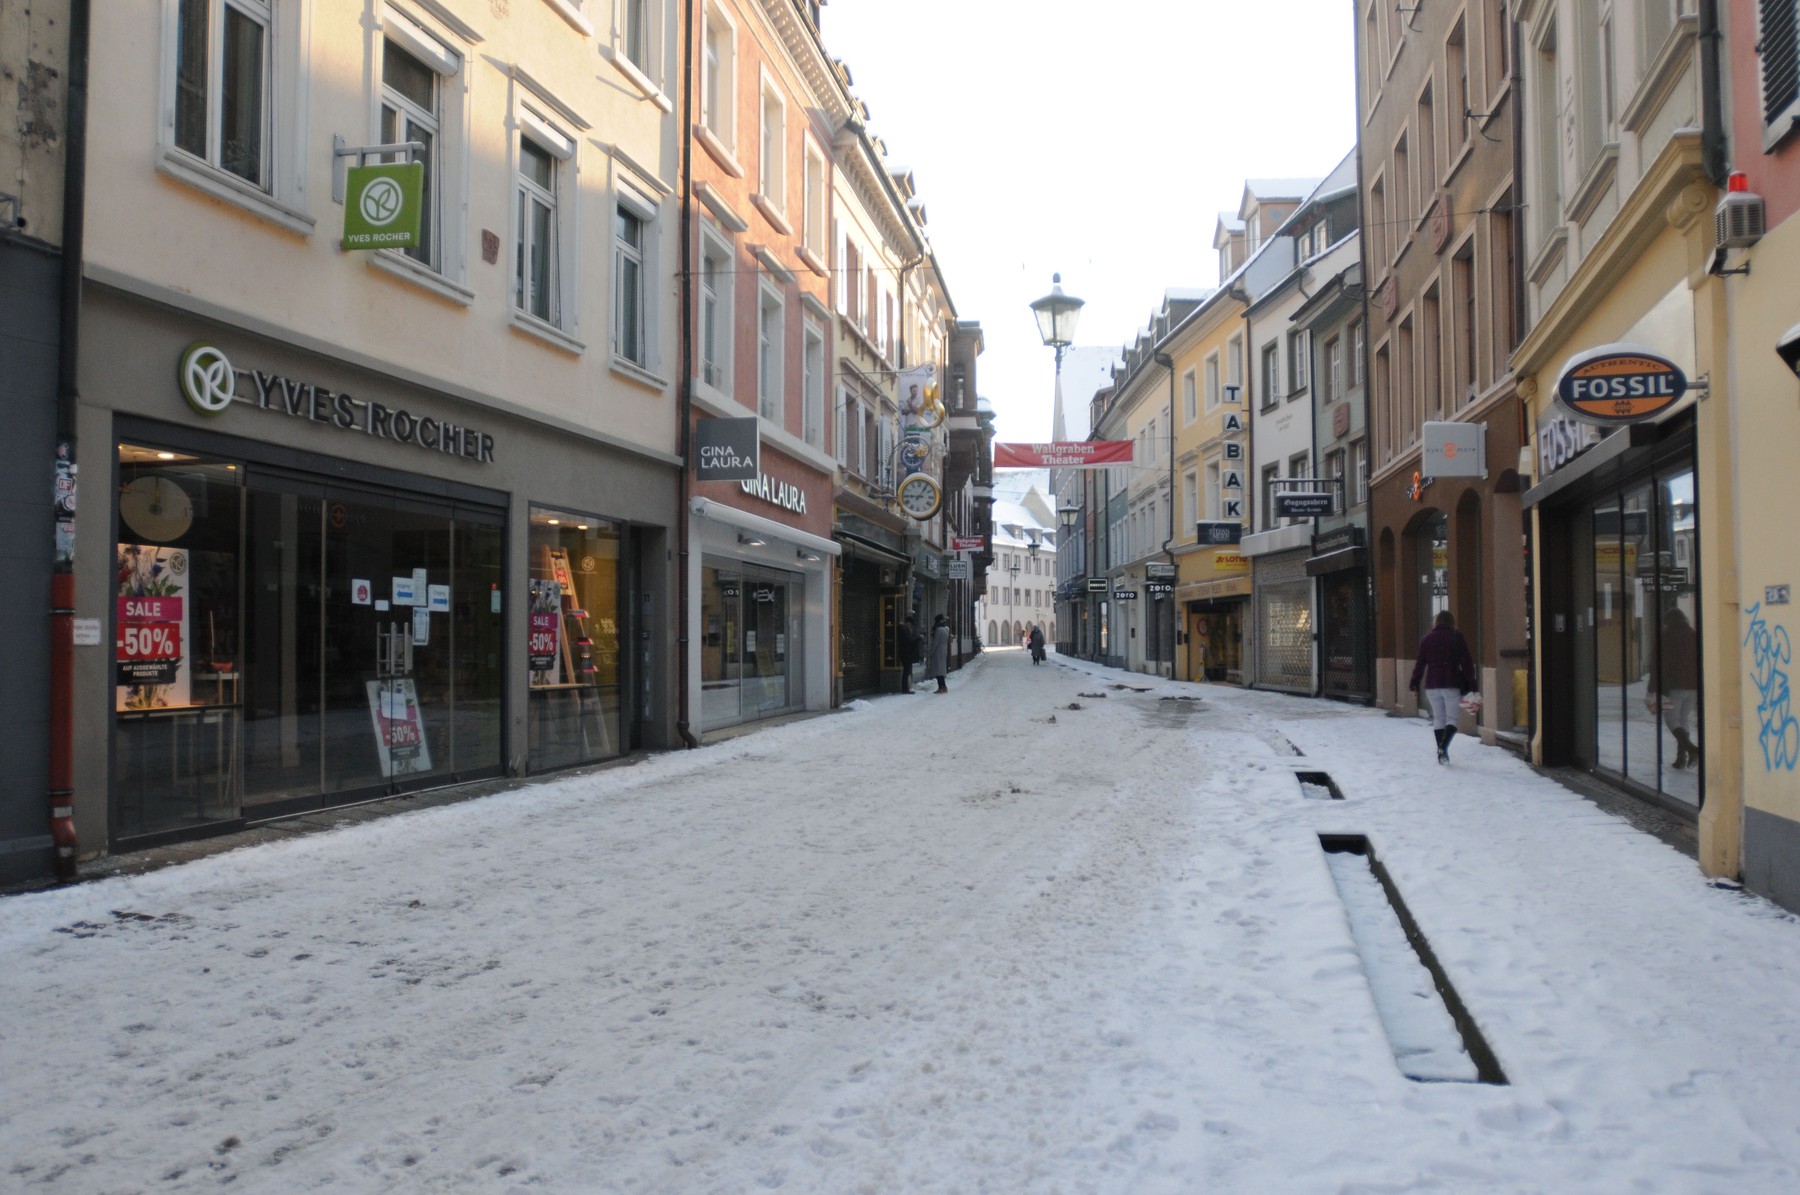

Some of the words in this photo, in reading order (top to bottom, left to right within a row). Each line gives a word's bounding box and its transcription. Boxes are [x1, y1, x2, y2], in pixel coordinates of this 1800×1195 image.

[348, 234, 370, 243] YVES
[372, 232, 411, 241] ROCHER
[1583, 359, 1663, 375] AUTHENTIC
[1573, 375, 1674, 399] FOSSIL
[251, 369, 356, 429] YVES
[366, 401, 495, 464] ROCHER
[701, 446, 735, 457] GINA
[1032, 444, 1095, 455] Wallgraben
[1226, 386, 1241, 516] TABAK
[701, 456, 754, 469] LAURA
[1041, 455, 1085, 465] Theater
[771, 477, 807, 515] LAURA
[1149, 584, 1172, 592] zero
[126, 601, 162, 617] SALE
[533, 615, 550, 626] SALE
[117, 628, 174, 656] -50%
[529, 632, 554, 652] -50%
[132, 670, 159, 678] PRODUKTE
[385, 725, 416, 743] -50%
